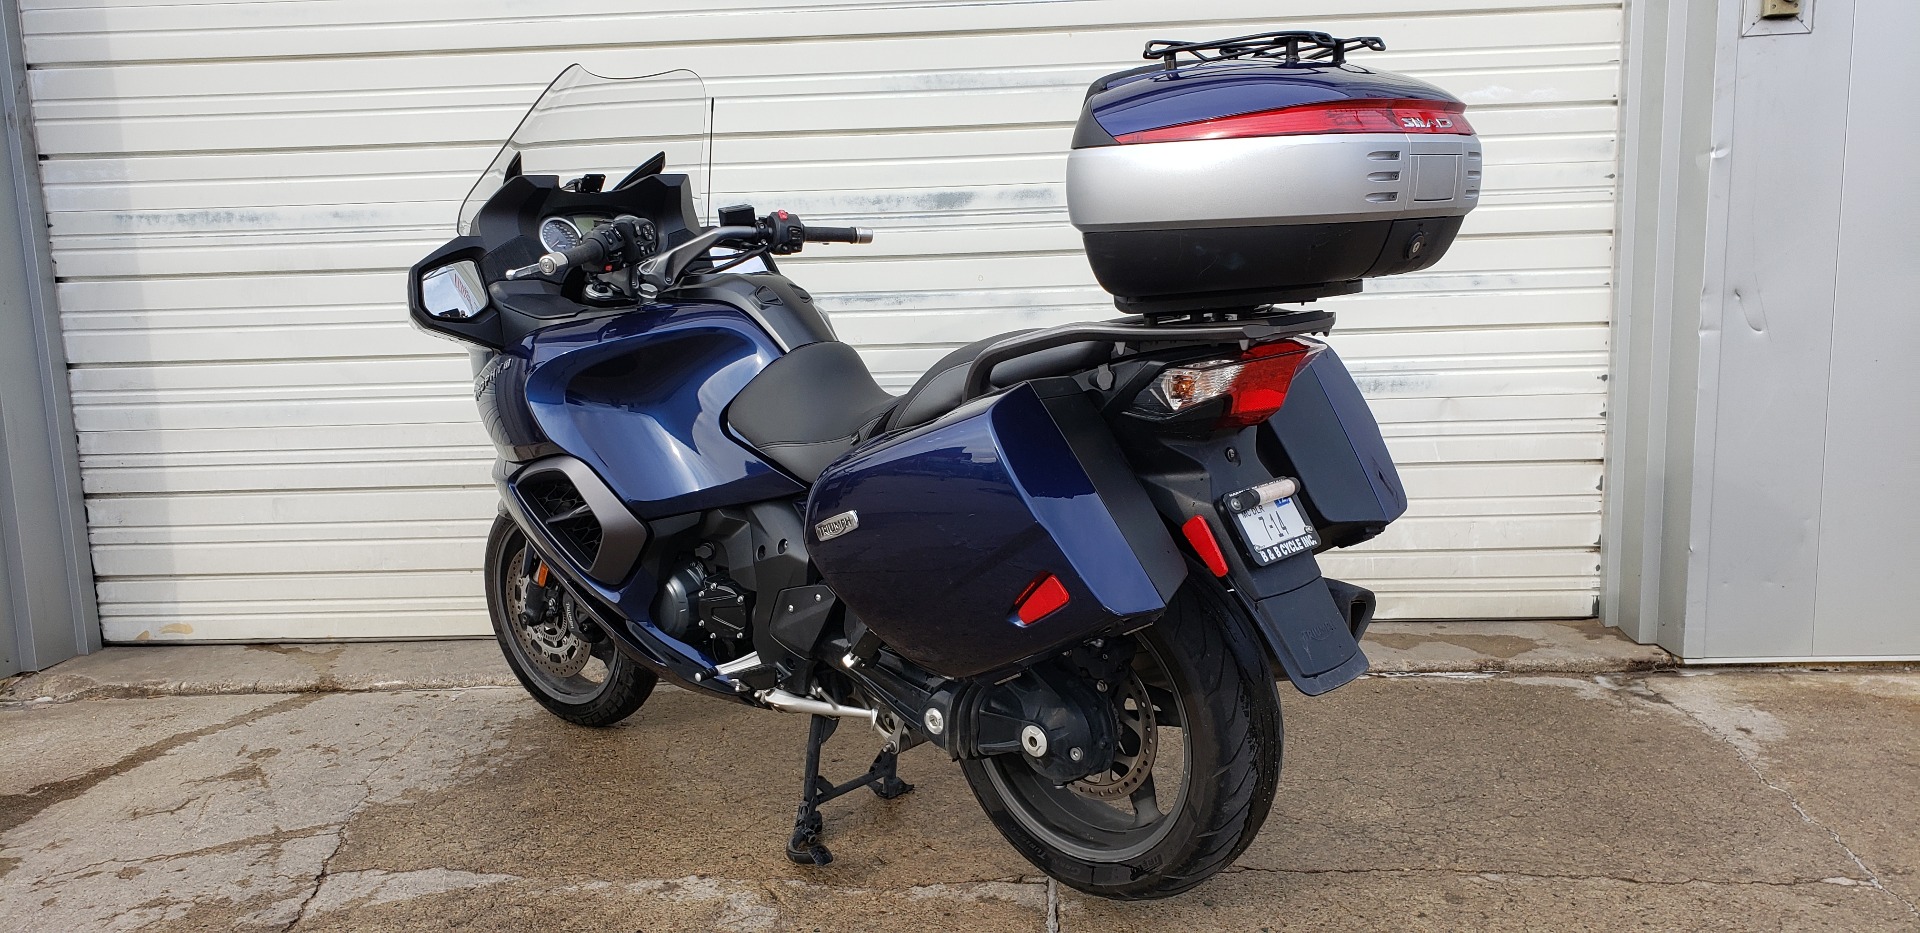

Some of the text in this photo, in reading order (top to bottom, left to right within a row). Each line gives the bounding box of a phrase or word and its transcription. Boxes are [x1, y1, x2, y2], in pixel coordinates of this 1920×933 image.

[817, 516, 852, 537] TRIUMPH
[1260, 550, 1269, 563] B
[1267, 547, 1276, 561] &
[1273, 545, 1283, 558] B
[1280, 538, 1304, 556] CYCLE
